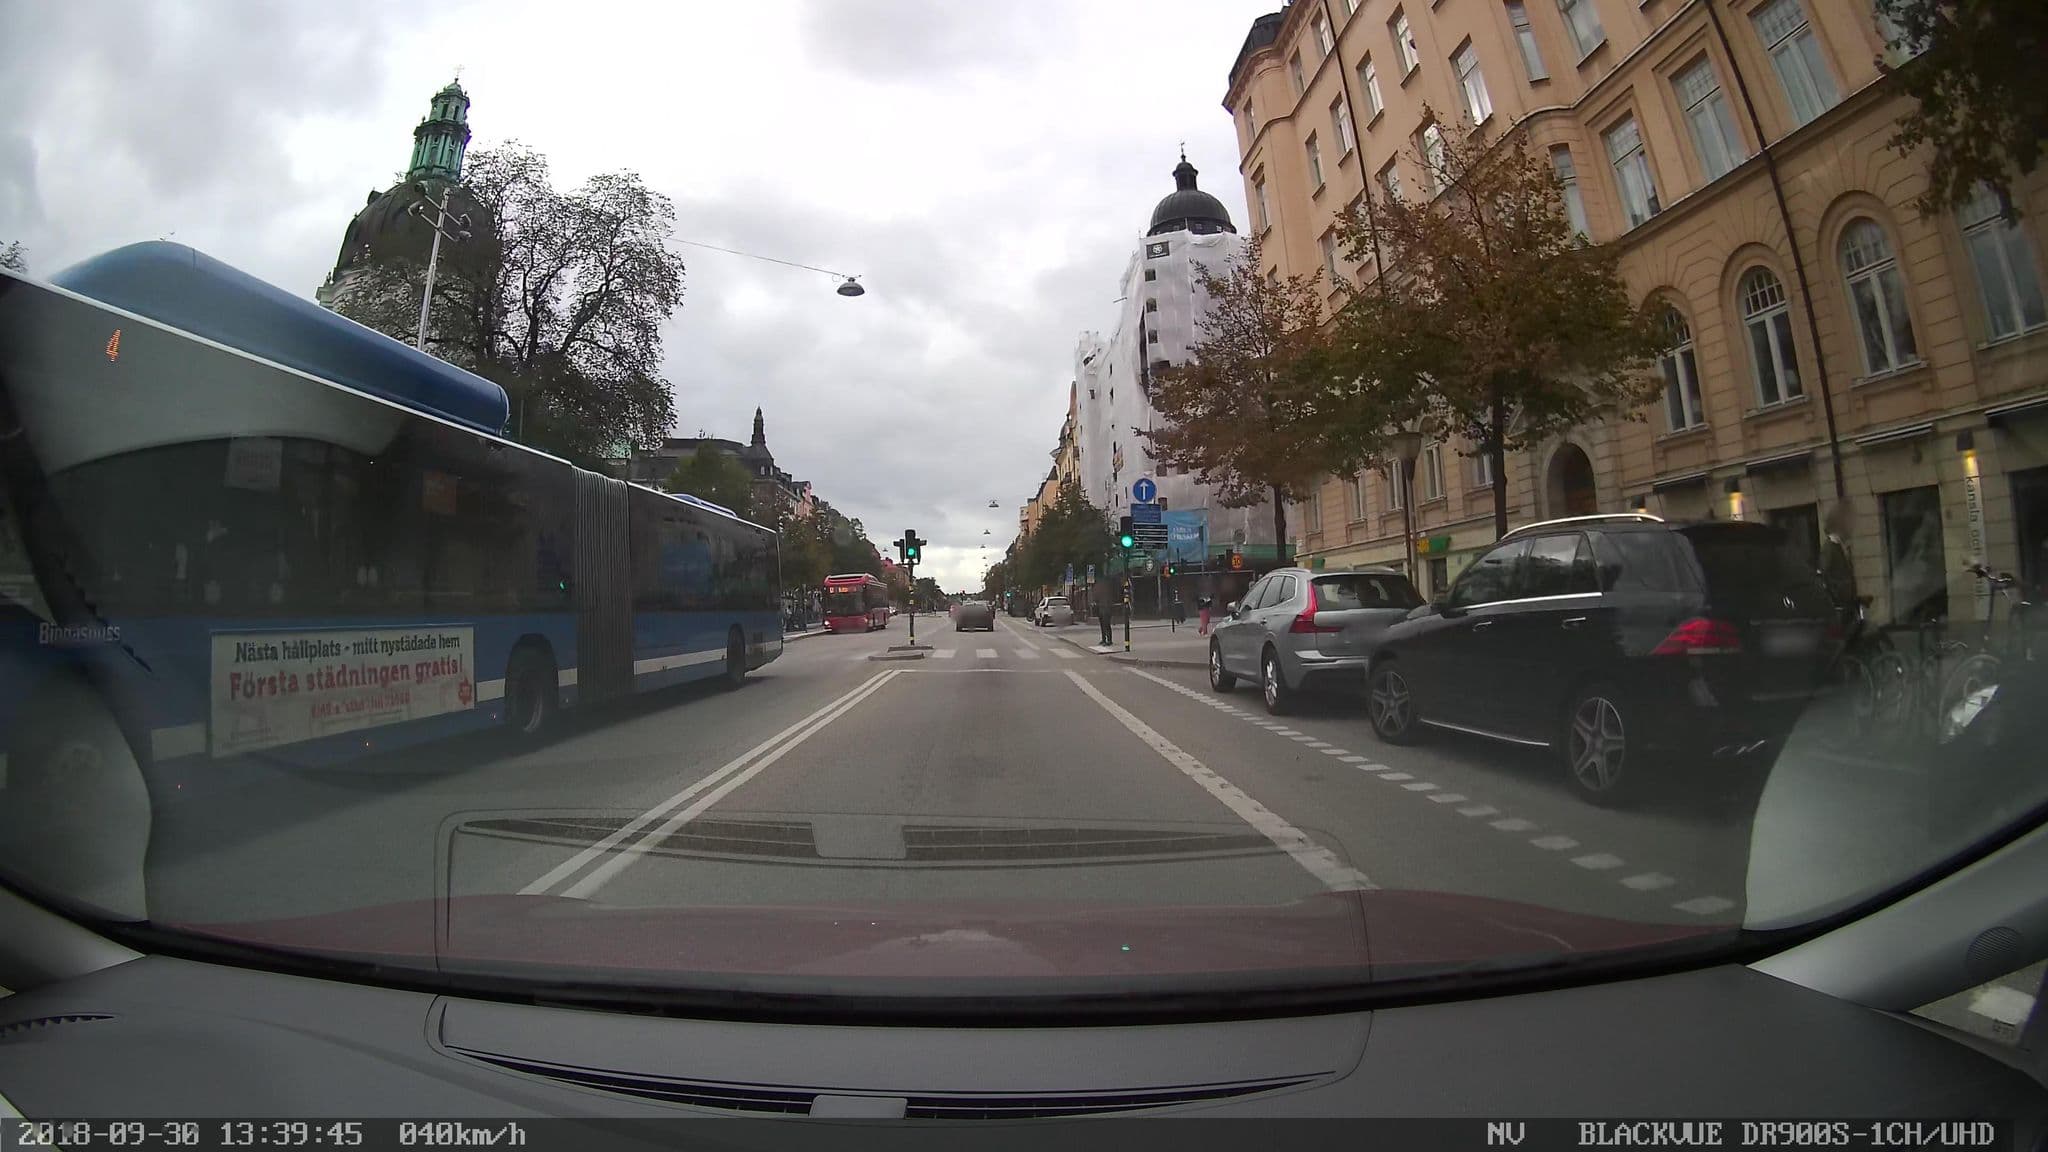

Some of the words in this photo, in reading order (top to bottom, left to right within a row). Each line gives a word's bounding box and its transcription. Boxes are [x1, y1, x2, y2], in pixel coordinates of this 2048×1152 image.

[235, 642, 278, 663] Nästa
[282, 639, 342, 663] hållplats
[352, 637, 378, 655] mitt
[380, 633, 436, 656] nystädade
[438, 633, 460, 649] hem
[230, 671, 299, 701] Första
[306, 662, 410, 691] städningen
[415, 653, 463, 684] gratis!
